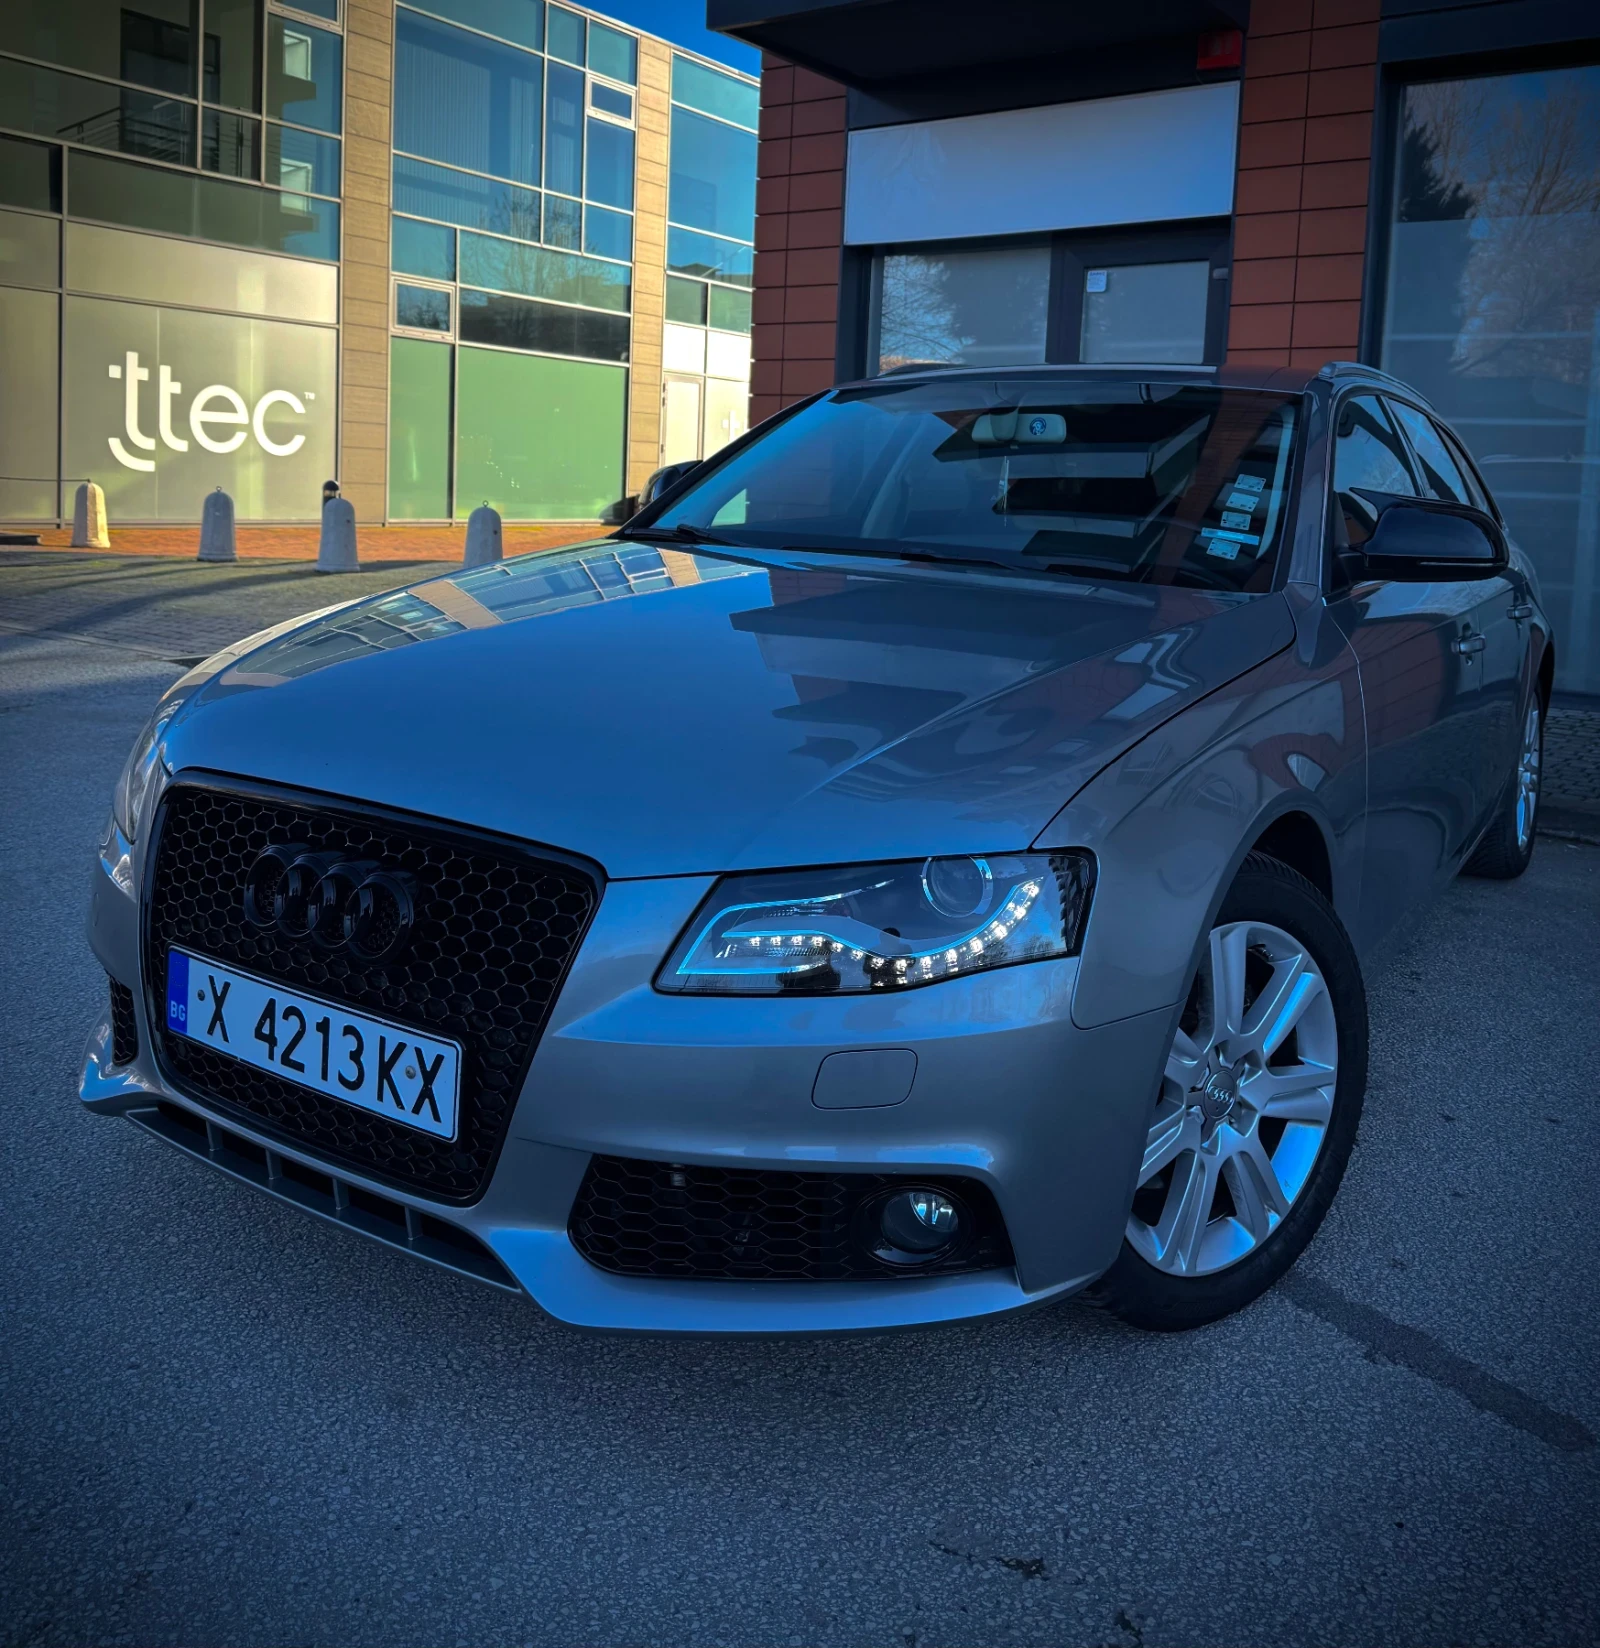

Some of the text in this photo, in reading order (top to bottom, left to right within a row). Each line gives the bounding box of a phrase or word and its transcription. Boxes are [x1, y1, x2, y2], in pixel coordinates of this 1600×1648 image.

[108, 350, 306, 472] ttec
[170, 1000, 187, 1022] BG
[206, 974, 232, 1044] X
